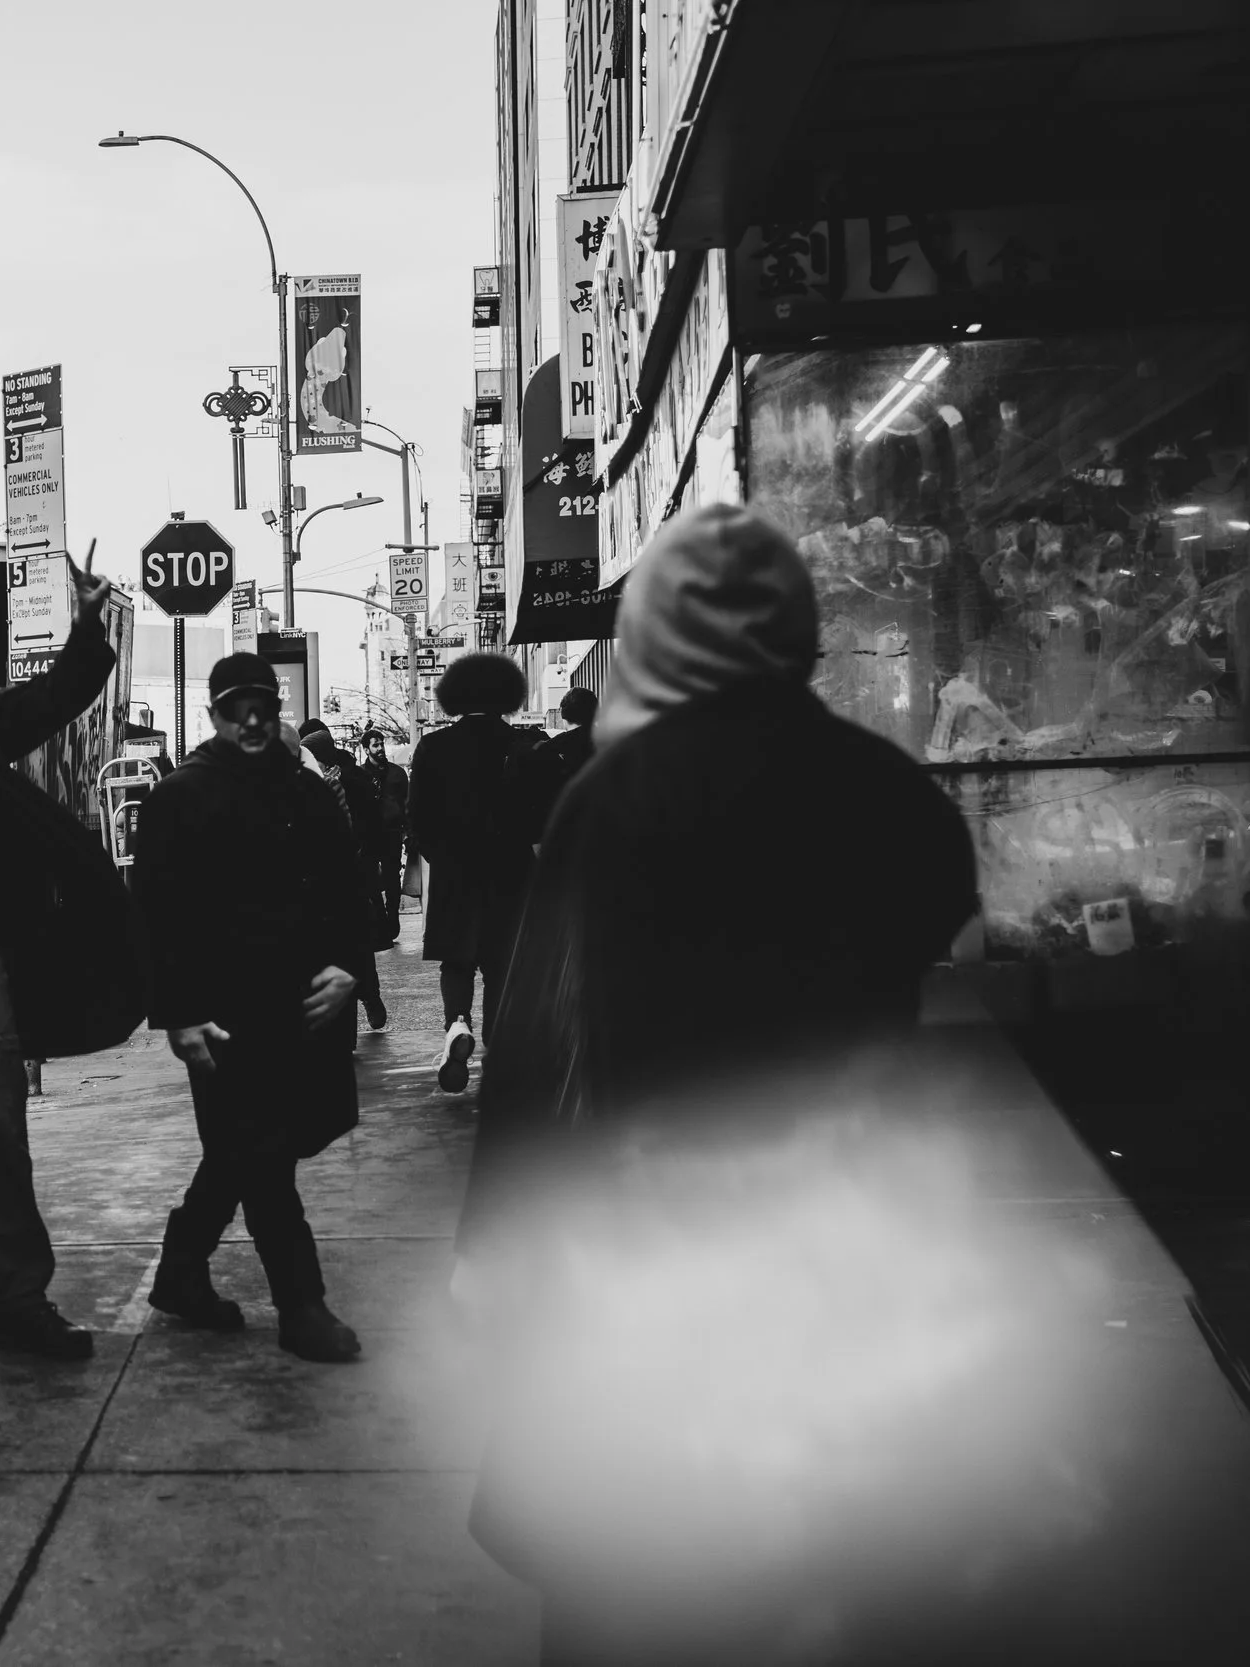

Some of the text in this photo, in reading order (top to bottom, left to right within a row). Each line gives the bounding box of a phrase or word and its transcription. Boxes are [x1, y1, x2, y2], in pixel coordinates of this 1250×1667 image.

[5, 372, 52, 392] NO STANDING
[6, 395, 18, 405] 7am
[21, 392, 34, 402] 8am
[6, 400, 45, 417] Except Sunday
[24, 442, 44, 452] metered
[302, 435, 356, 447] FLUSHING
[10, 438, 20, 461] 3
[24, 452, 43, 462] parking
[8, 468, 52, 486] COMMERCIAL
[9, 481, 59, 499] VEHICLES ONLY
[10, 515, 22, 526] 8am
[26, 513, 38, 524] 7pm
[10, 523, 50, 537] Except Sunday
[392, 558, 423, 566] SPEED
[13, 562, 24, 586] 5
[146, 552, 229, 588] STOP
[396, 566, 420, 576] LIMIT
[395, 578, 422, 596] 20
[28, 595, 52, 605] Midnight
[32, 607, 52, 617] Sunday
[394, 604, 425, 612] ENFORCED
[234, 612, 239, 624] 3
[12, 659, 55, 678] 10444
